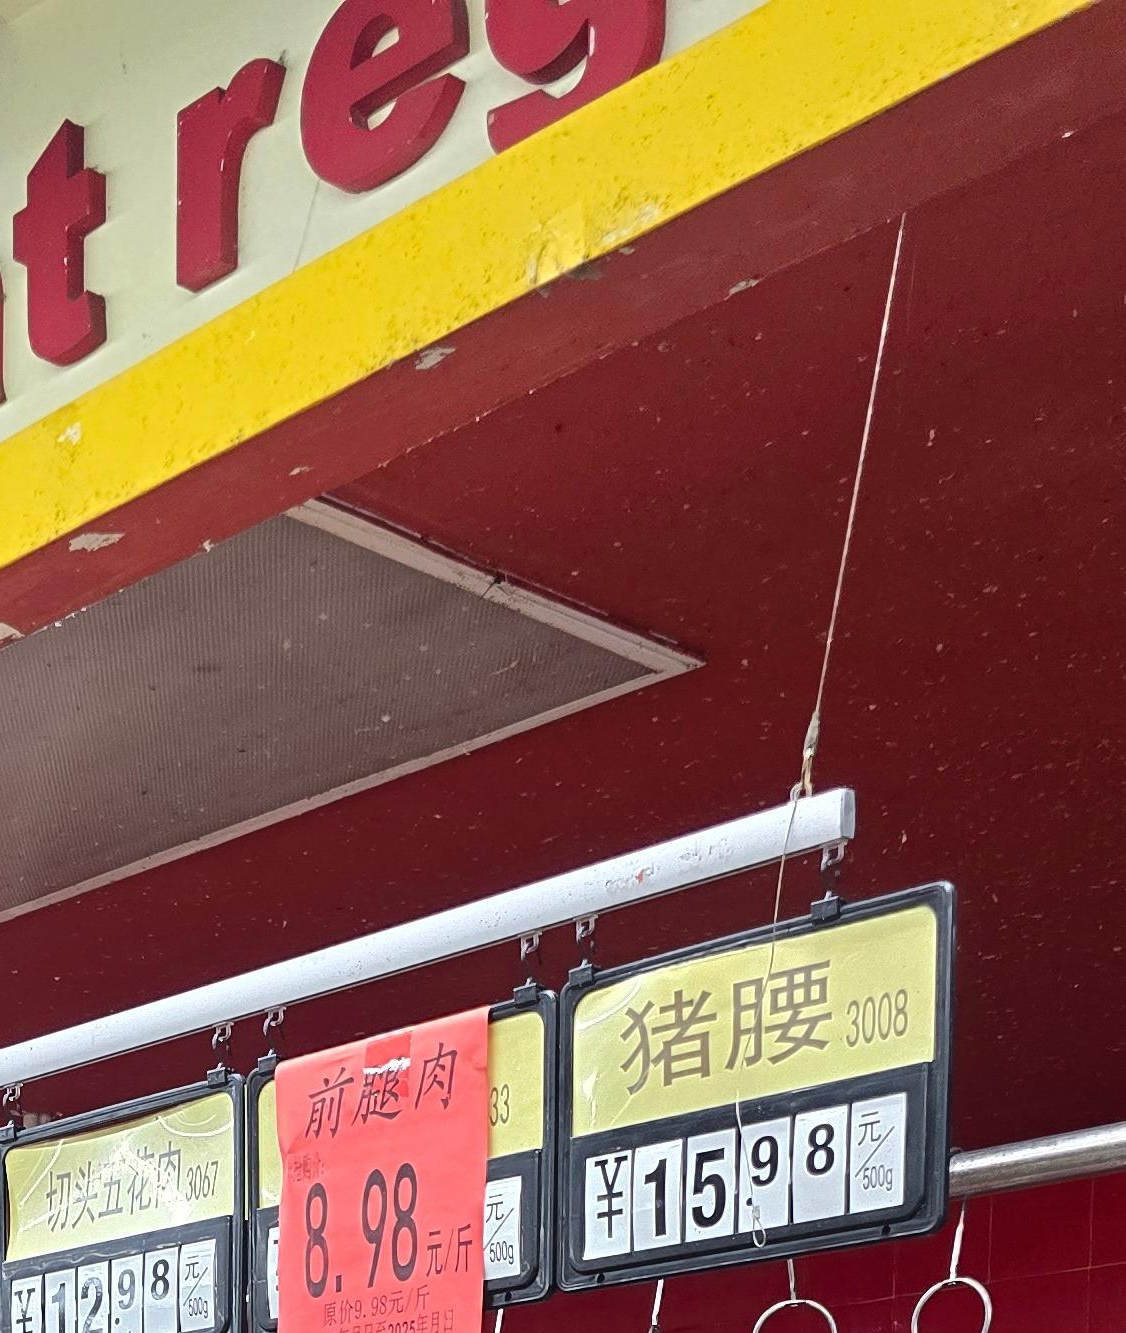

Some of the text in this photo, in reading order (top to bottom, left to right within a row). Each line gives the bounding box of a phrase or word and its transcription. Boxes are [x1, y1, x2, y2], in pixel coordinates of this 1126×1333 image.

[620, 959, 908, 1096] 猪腰 3008
[305, 1043, 457, 1138] 前腿肉
[489, 1083, 510, 1127] 33
[186, 1161, 219, 1202] 3067
[305, 1162, 418, 1299] 8.98
